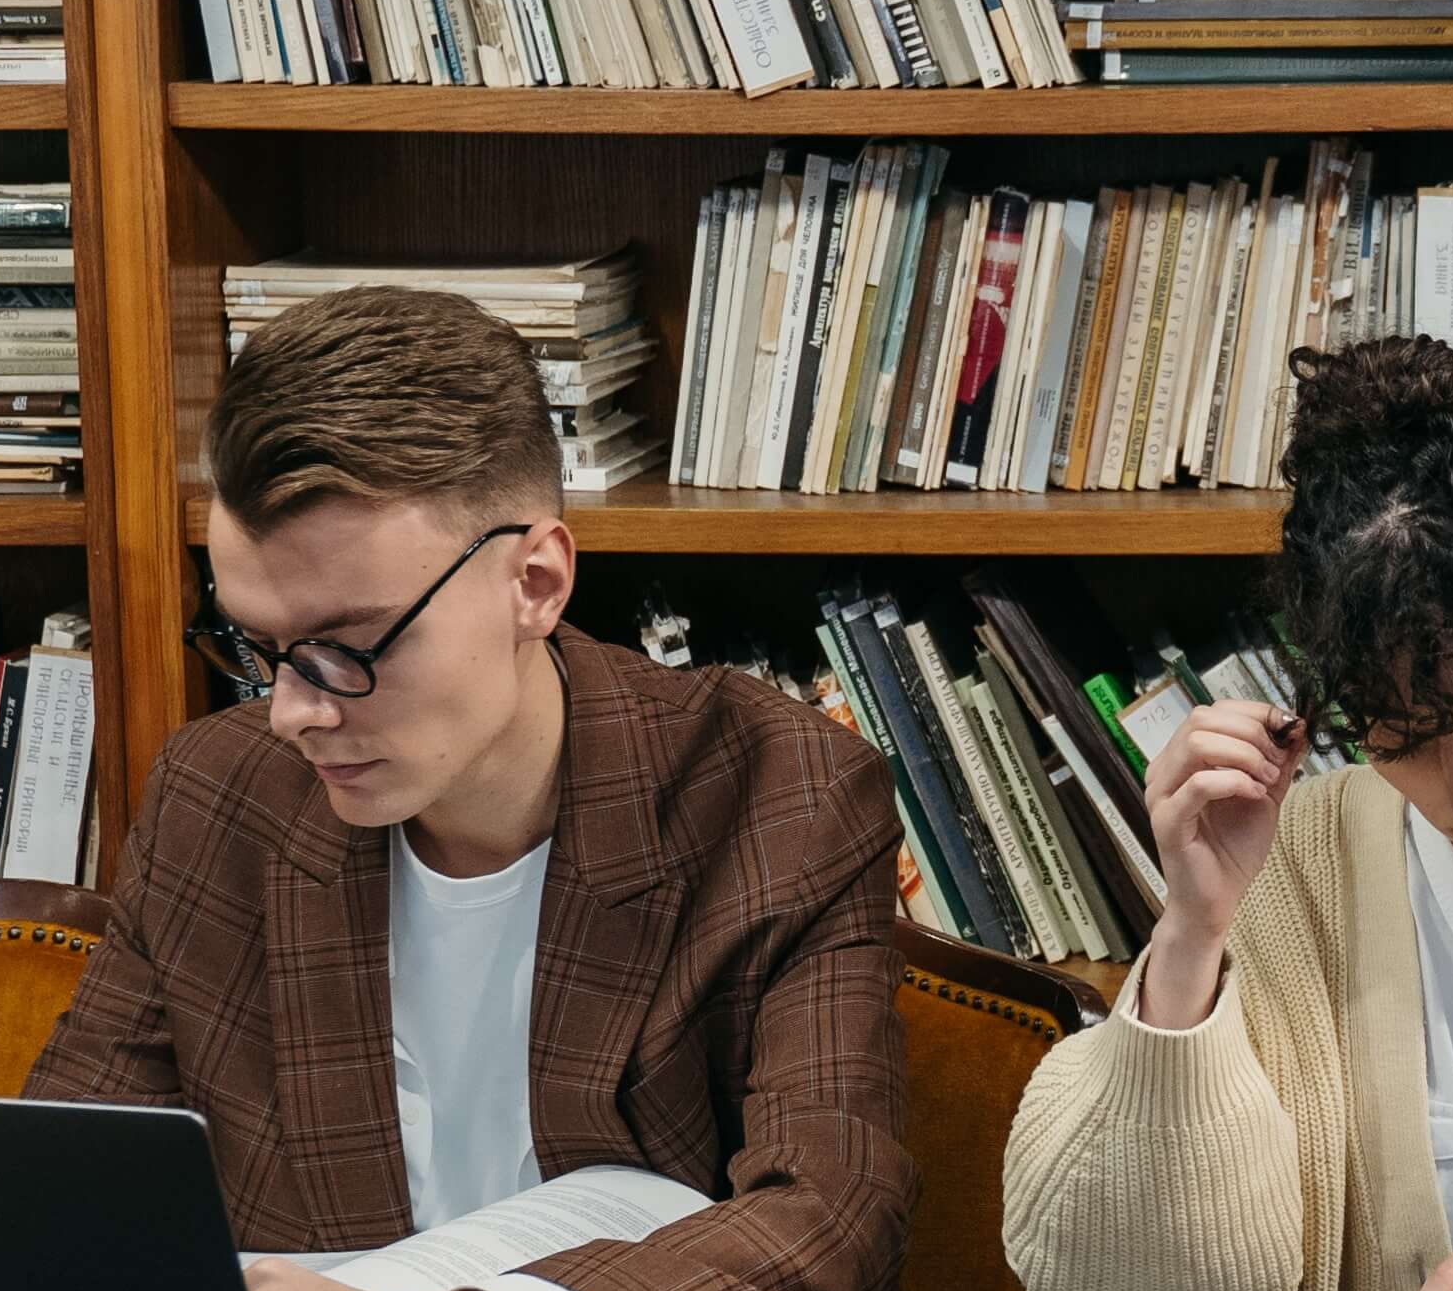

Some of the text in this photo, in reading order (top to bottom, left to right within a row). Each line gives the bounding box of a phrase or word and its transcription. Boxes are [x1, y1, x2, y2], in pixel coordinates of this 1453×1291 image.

[790, 193, 817, 316] ЖИЛИЩЕ ДЛЯ ЧЕЛОВЕКА
[918, 629, 944, 672] СРЕДА
[968, 704, 1009, 783] архитектура
[986, 706, 1029, 787] архитектура
[1006, 791, 1036, 844] природы
[1025, 797, 1055, 848] природы
[1027, 842, 1053, 887] Охрана
[1046, 847, 1073, 892] Охрана
